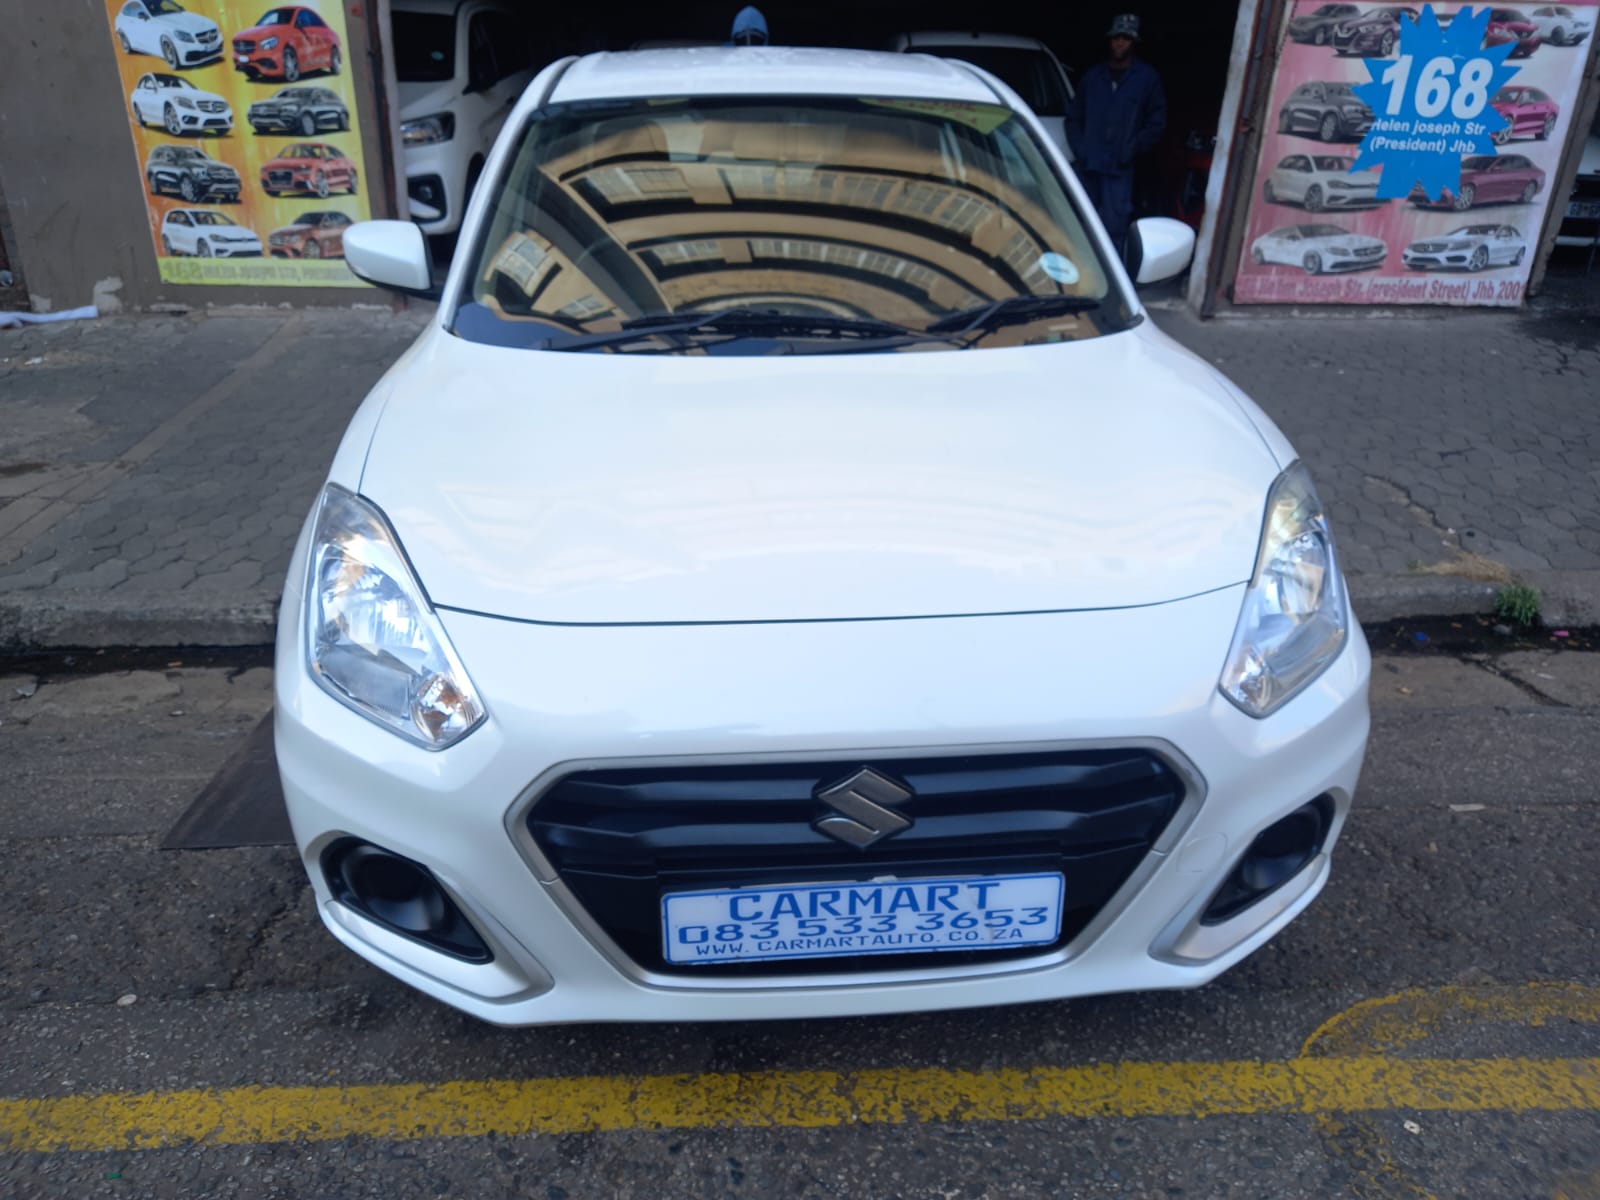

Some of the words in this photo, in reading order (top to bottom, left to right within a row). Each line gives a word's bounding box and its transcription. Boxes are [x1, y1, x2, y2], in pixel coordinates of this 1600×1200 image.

[1382, 54, 1494, 120] 168
[1412, 119, 1461, 136] joseph
[1464, 122, 1486, 135] Str
[1370, 136, 1446, 154] (President)
[1449, 139, 1476, 153] Jhb
[1472, 281, 1494, 299] Jhb
[729, 882, 1000, 922] CARMART
[798, 914, 897, 938] 533
[915, 906, 1049, 932] 3653
